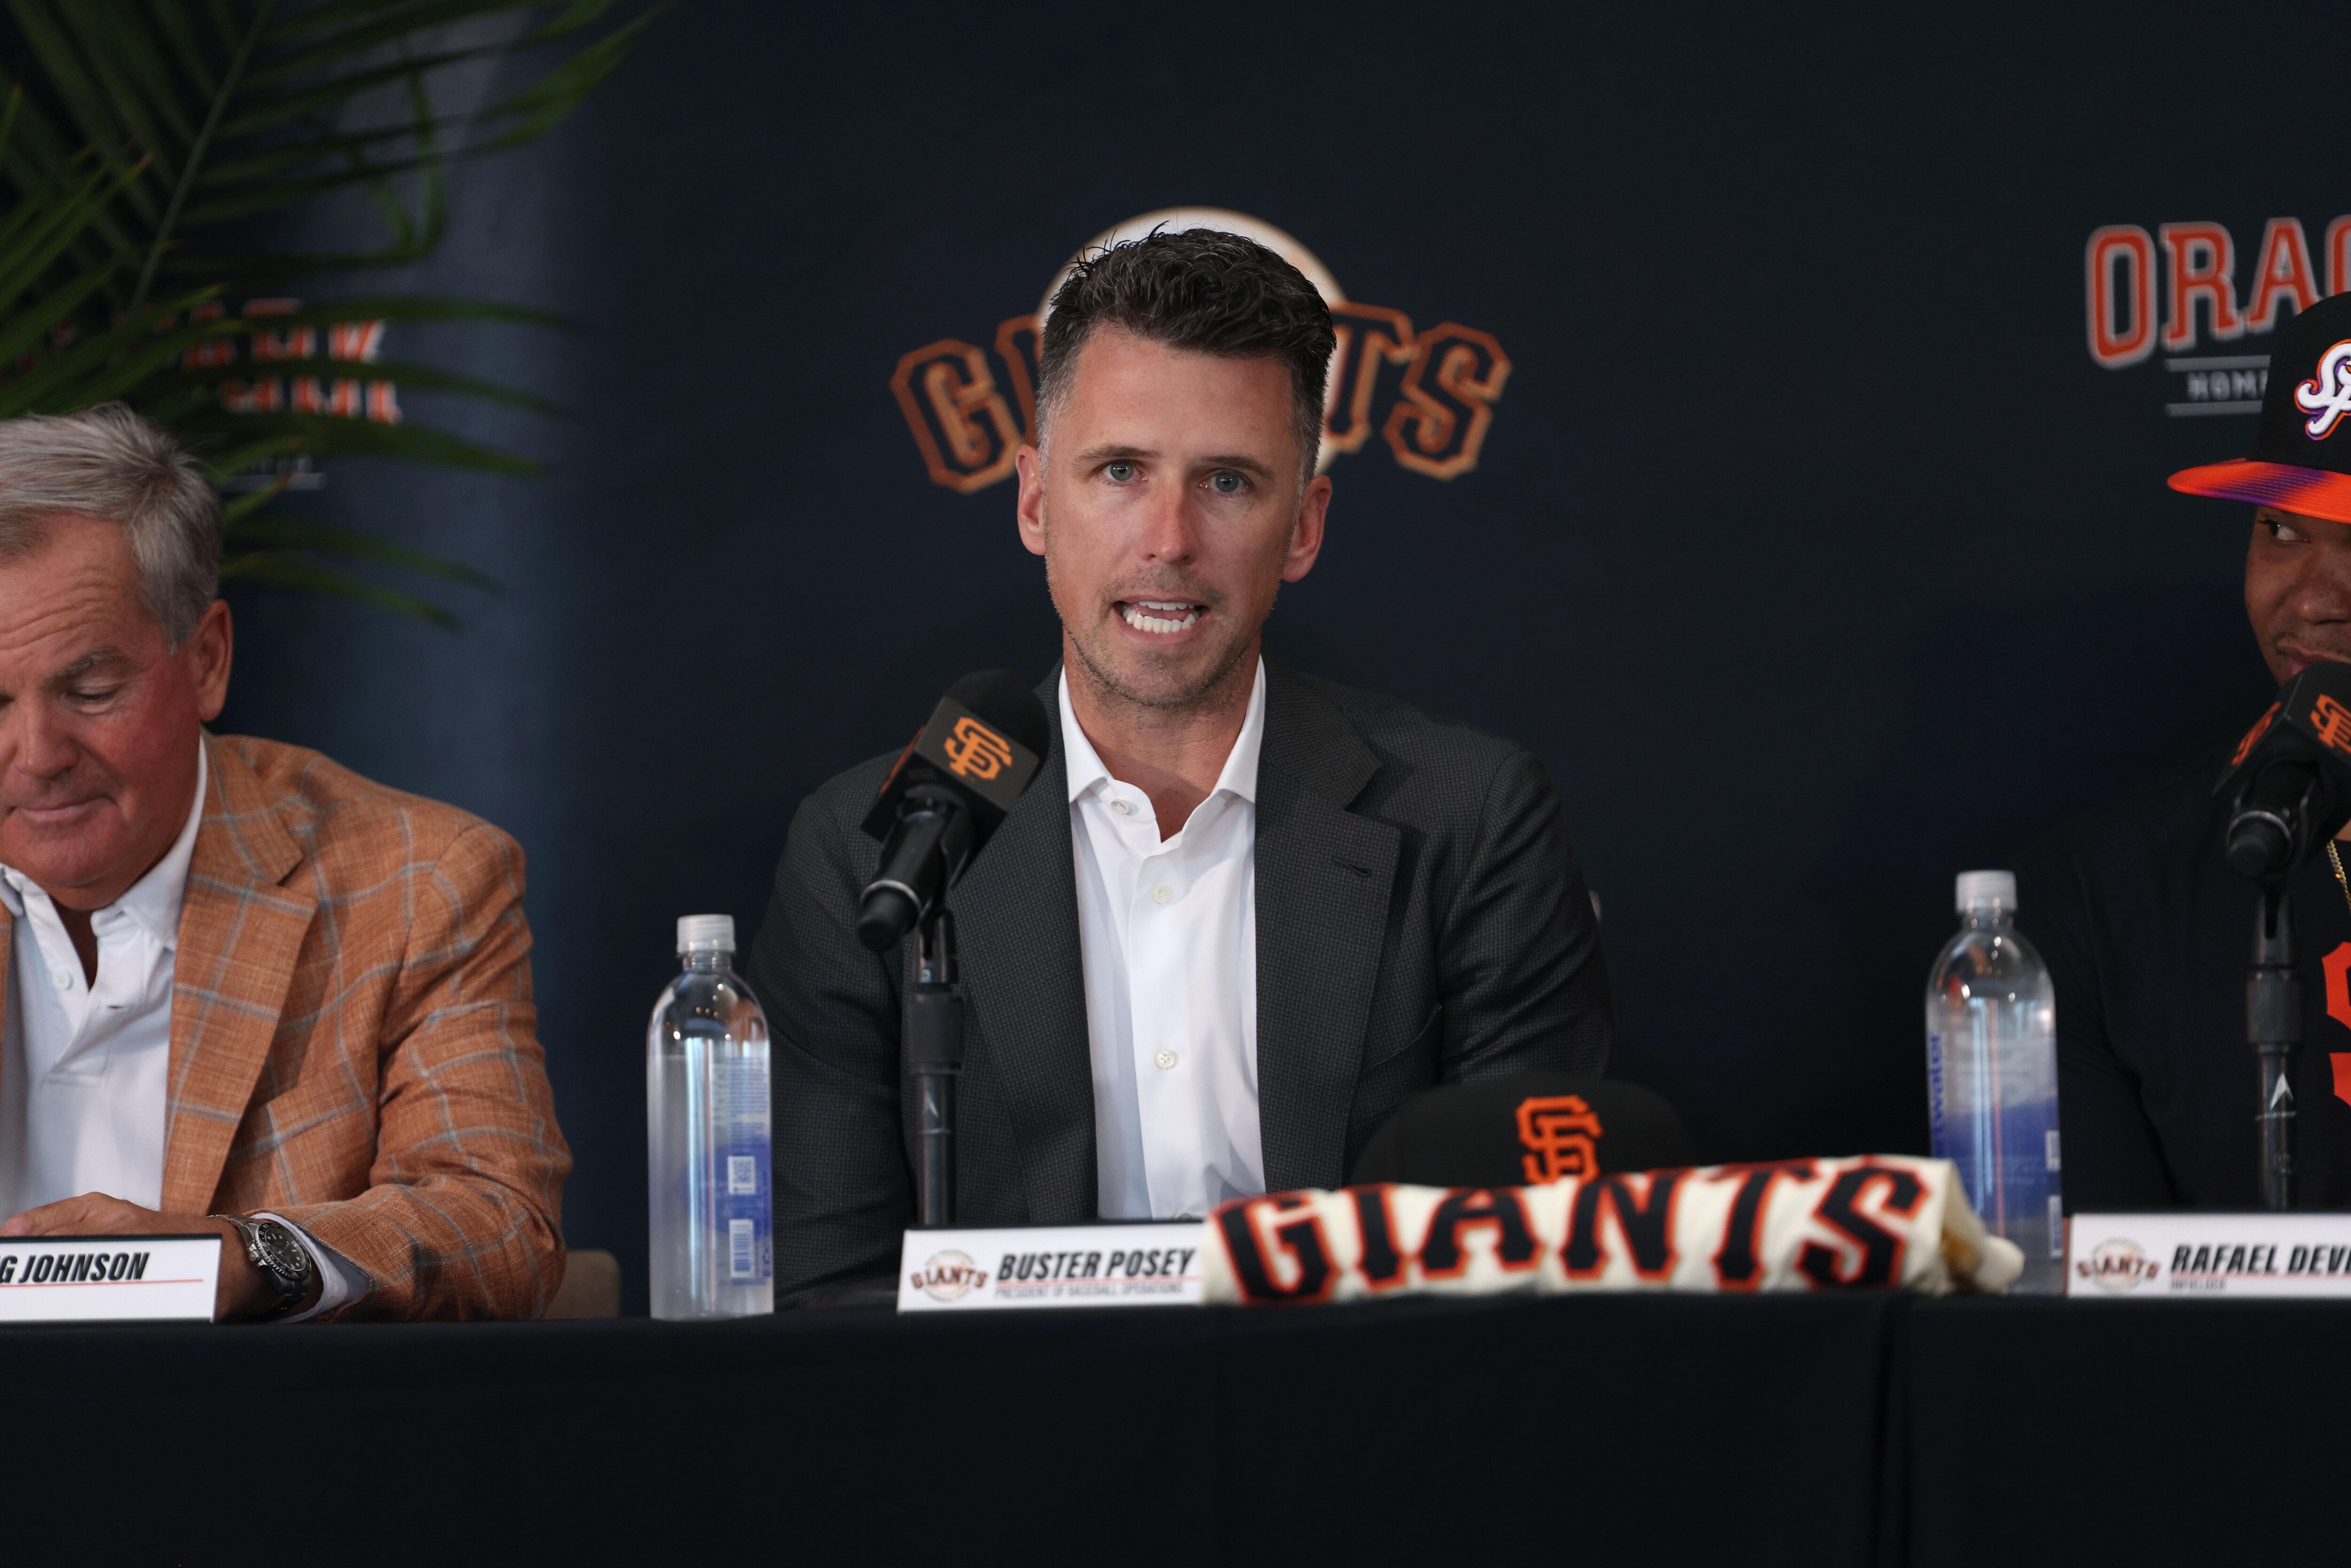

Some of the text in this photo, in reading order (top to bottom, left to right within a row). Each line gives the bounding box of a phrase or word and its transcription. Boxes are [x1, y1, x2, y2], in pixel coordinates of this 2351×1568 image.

[944, 716, 1012, 780] SF
[1515, 1094, 1604, 1184] SF
[1209, 1155, 1931, 1307] GIANTS
[17, 1252, 150, 1284] JOHNSON
[996, 1247, 1195, 1281] BUSTER POSEY
[2171, 1244, 2277, 1275] RAFAEL
